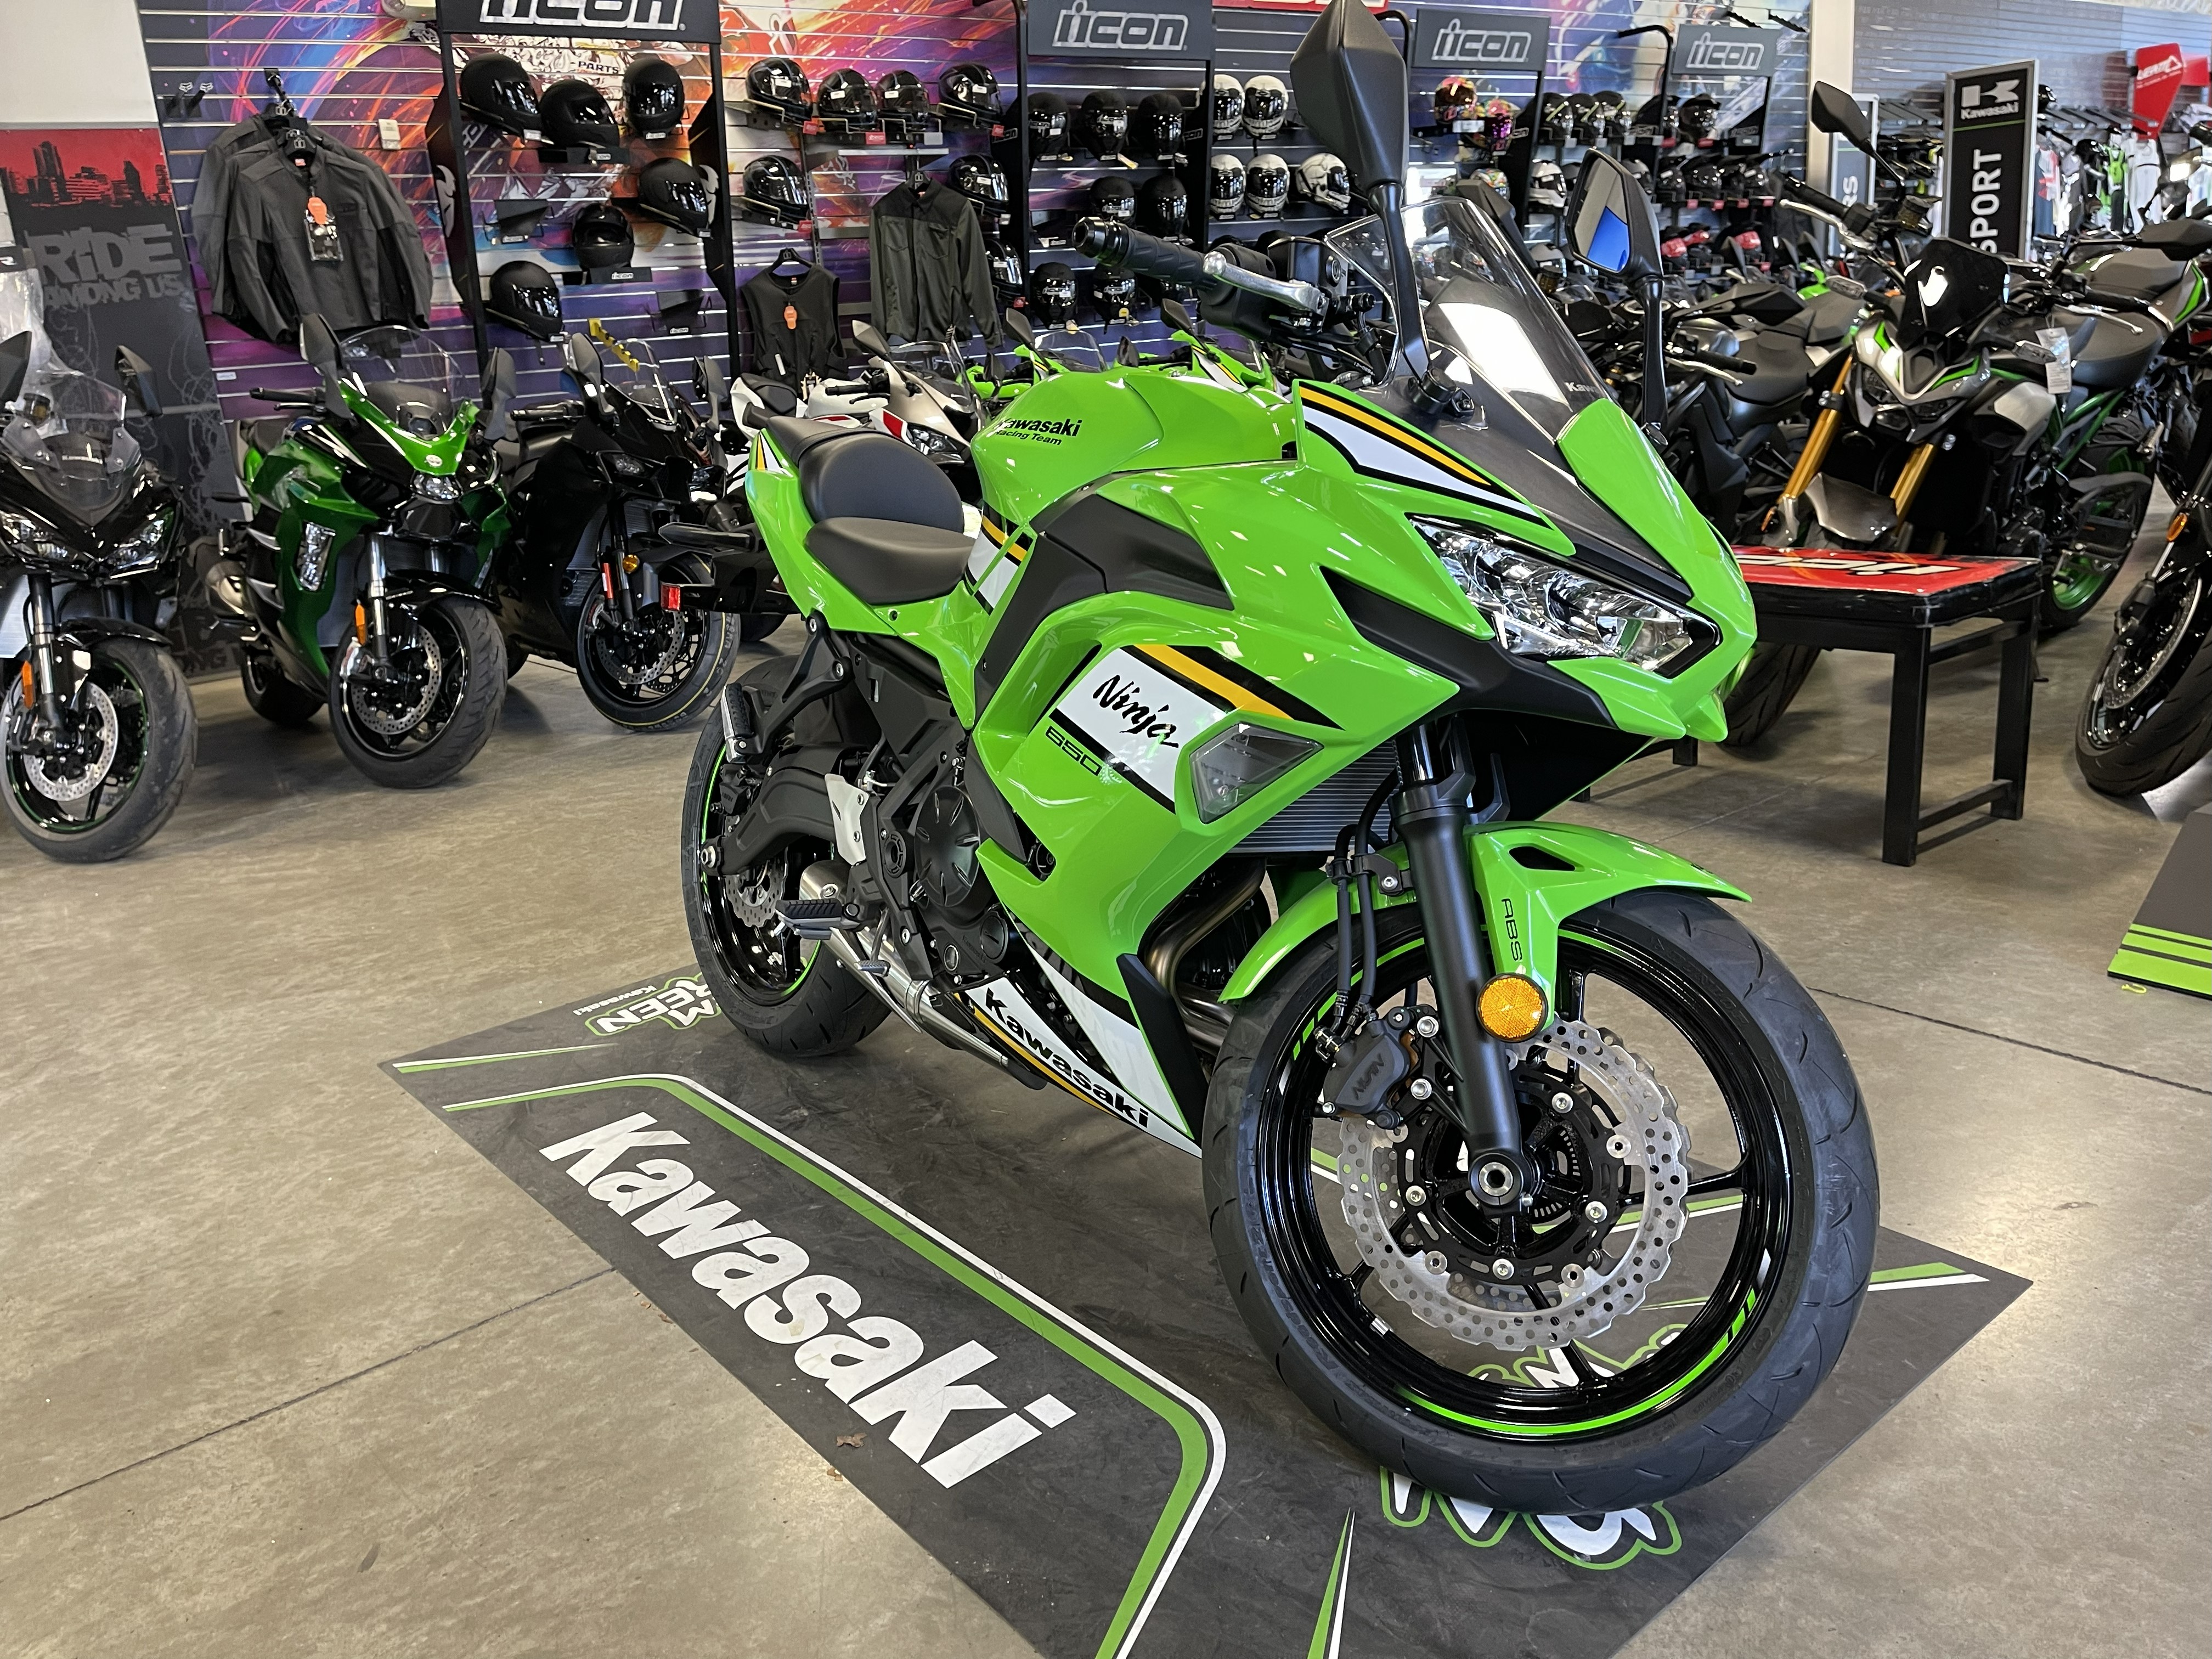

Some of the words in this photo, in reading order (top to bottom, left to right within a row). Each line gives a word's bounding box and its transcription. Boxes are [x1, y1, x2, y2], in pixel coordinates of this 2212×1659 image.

[577, 60, 620, 75] PARTS
[1960, 102, 2019, 120] Kawasaki
[43, 277, 142, 308] AMONG
[144, 274, 185, 299] US
[1031, 433, 1062, 445] Team
[1092, 674, 1179, 748] Ninja
[1045, 725, 1103, 777] 650
[1500, 898, 1523, 963] ABS
[573, 985, 657, 1015] Kawasaki
[986, 987, 1150, 1130] Kawasaki
[1352, 1053, 1385, 1101] NISSIN
[539, 1111, 1077, 1490] Kawasaki
